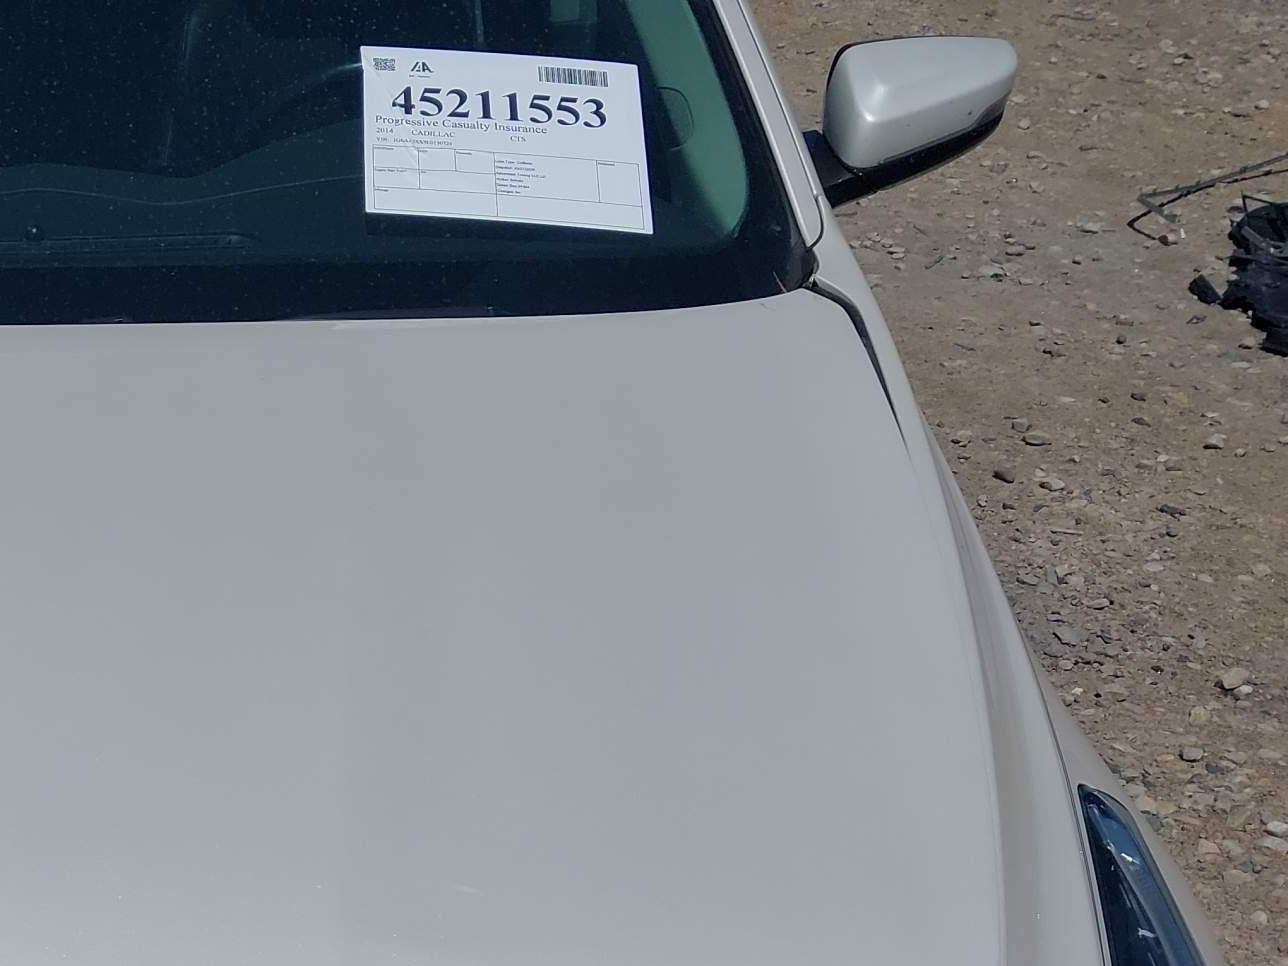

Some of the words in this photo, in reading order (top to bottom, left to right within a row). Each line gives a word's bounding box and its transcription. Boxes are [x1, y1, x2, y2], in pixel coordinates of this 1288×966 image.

[391, 86, 607, 128] 45211553
[375, 114, 439, 127] Progressive
[442, 119, 491, 133] Casualty
[494, 121, 548, 135] Insurance
[411, 129, 456, 138] CADILLAC
[510, 135, 527, 143] CTS
